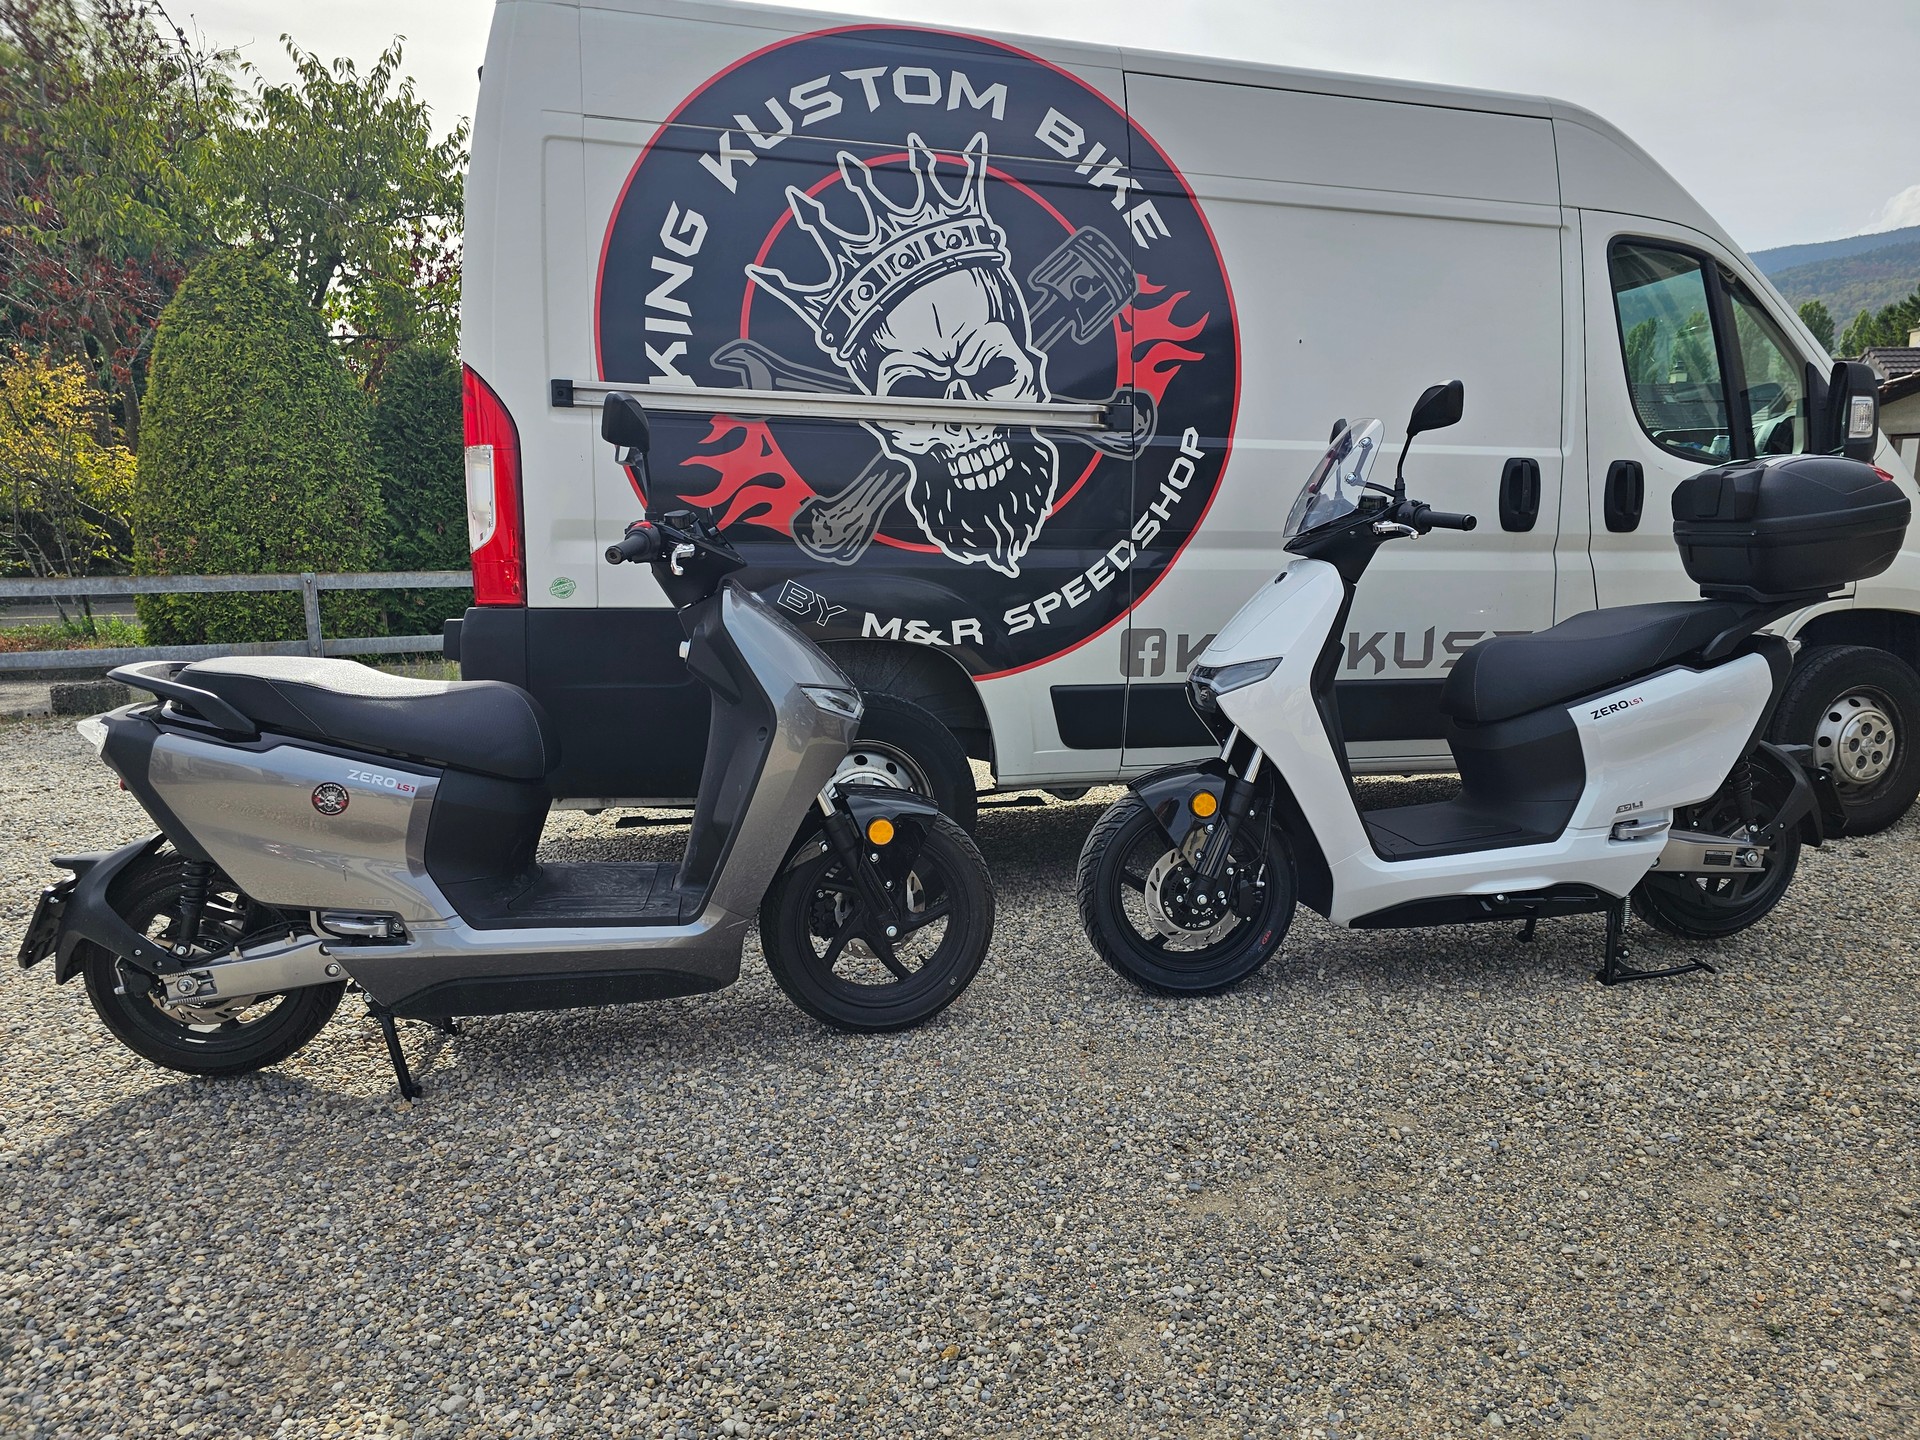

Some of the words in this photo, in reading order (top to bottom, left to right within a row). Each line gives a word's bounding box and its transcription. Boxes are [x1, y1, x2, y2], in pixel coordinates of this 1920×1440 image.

[644, 200, 709, 387] KING
[699, 65, 1007, 193] KUSTOM
[1034, 106, 1171, 249] BIKE
[777, 579, 847, 626] BY
[861, 612, 984, 646] M&R
[1003, 426, 1206, 636] SPEEDSHOP
[1590, 700, 1629, 720] ZERO
[1629, 697, 1644, 706] LS1
[347, 769, 397, 788] ZERO
[396, 783, 416, 793] LS1
